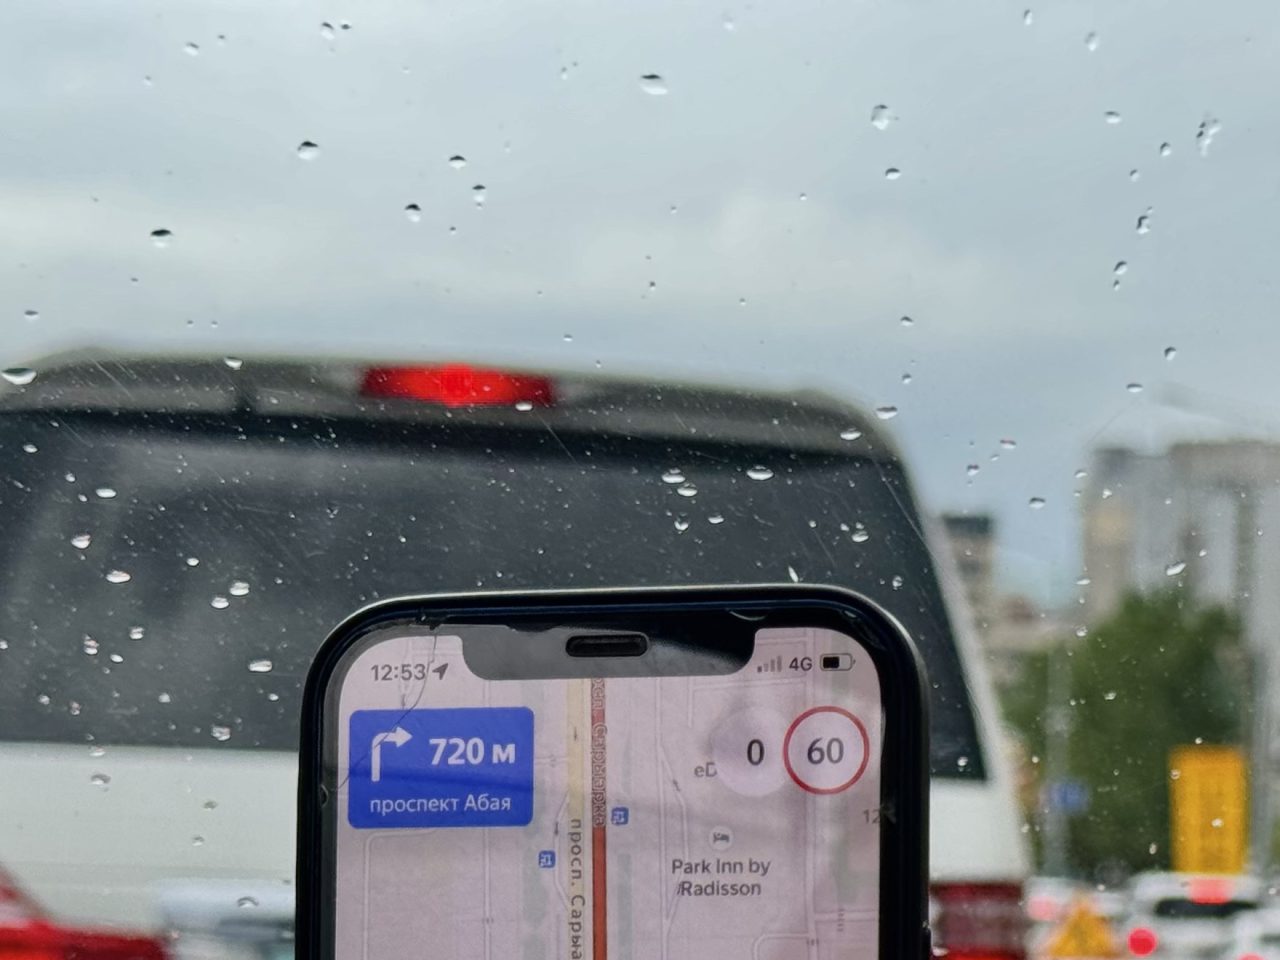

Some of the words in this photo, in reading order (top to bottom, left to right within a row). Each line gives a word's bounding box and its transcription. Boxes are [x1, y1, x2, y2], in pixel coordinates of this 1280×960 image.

[371, 663, 426, 681] 12:53
[789, 657, 813, 672] 4G
[429, 737, 485, 765] 720
[747, 739, 765, 766] 0
[807, 738, 844, 764] 60
[370, 798, 459, 816] проспект
[464, 793, 511, 812] Абая
[568, 819, 582, 886] просп.
[671, 858, 711, 875] Park
[717, 858, 744, 874] Inn
[749, 858, 772, 876] by
[680, 881, 762, 896] Radisson
